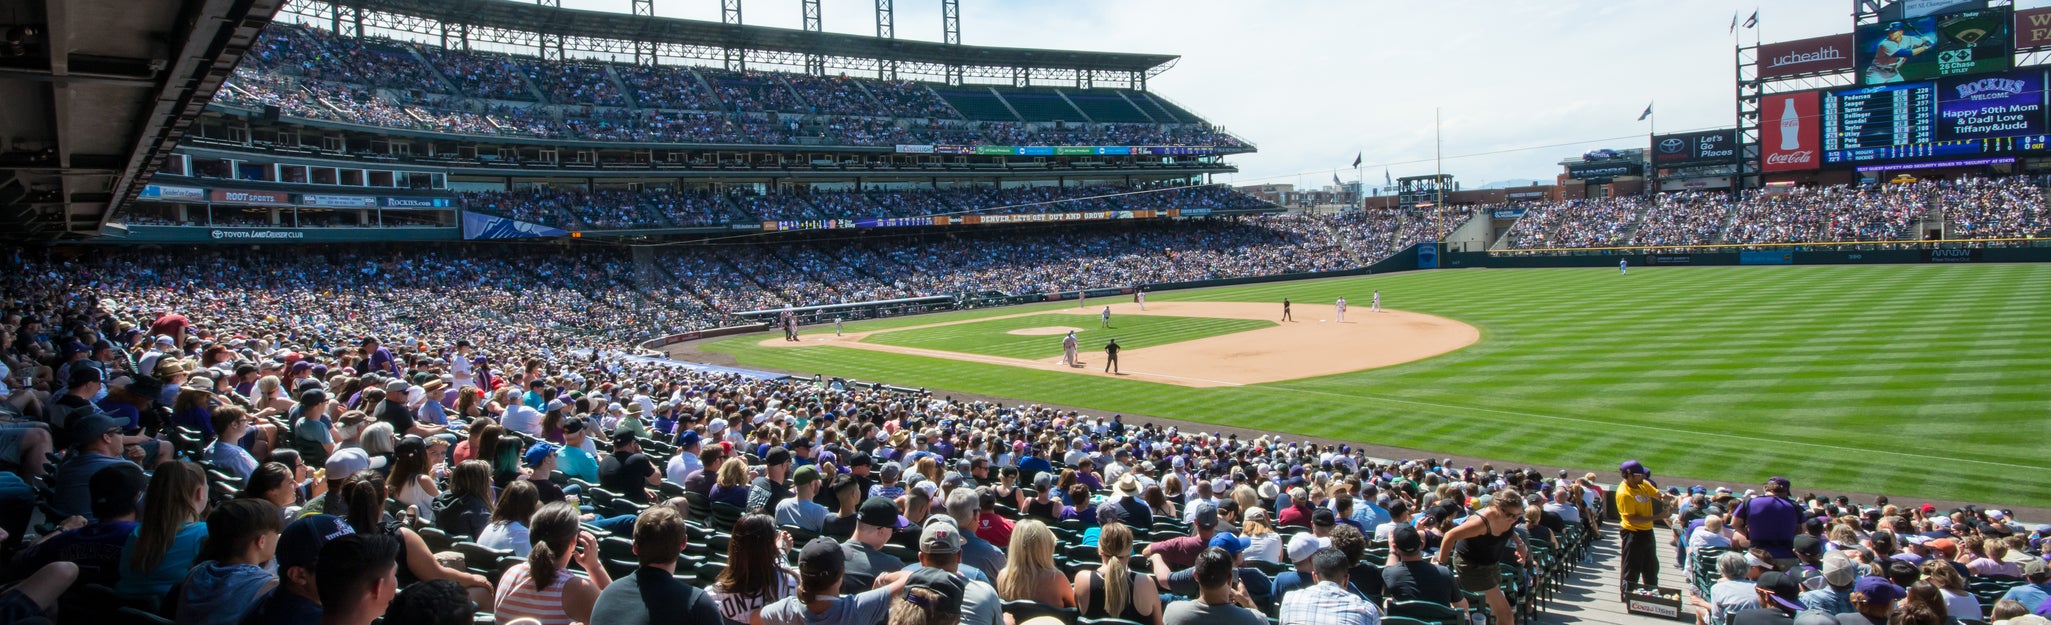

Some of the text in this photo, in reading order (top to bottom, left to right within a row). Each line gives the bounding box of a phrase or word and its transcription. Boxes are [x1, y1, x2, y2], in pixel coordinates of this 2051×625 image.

[1773, 46, 1839, 66] uchealth
[1955, 78, 2025, 99] ROCKIES
[1971, 92, 2009, 100] WELCOME
[1943, 104, 2038, 118] Happy 50th Mom
[1968, 115, 1993, 124] Dad!
[1997, 114, 2024, 122] Love
[1954, 121, 2027, 133] Tiffany&Judd
[1700, 134, 1723, 143] Let's
[1700, 149, 1733, 158] Places
[1766, 150, 1814, 165] Coca-Cola
[226, 192, 248, 201] ROOT
